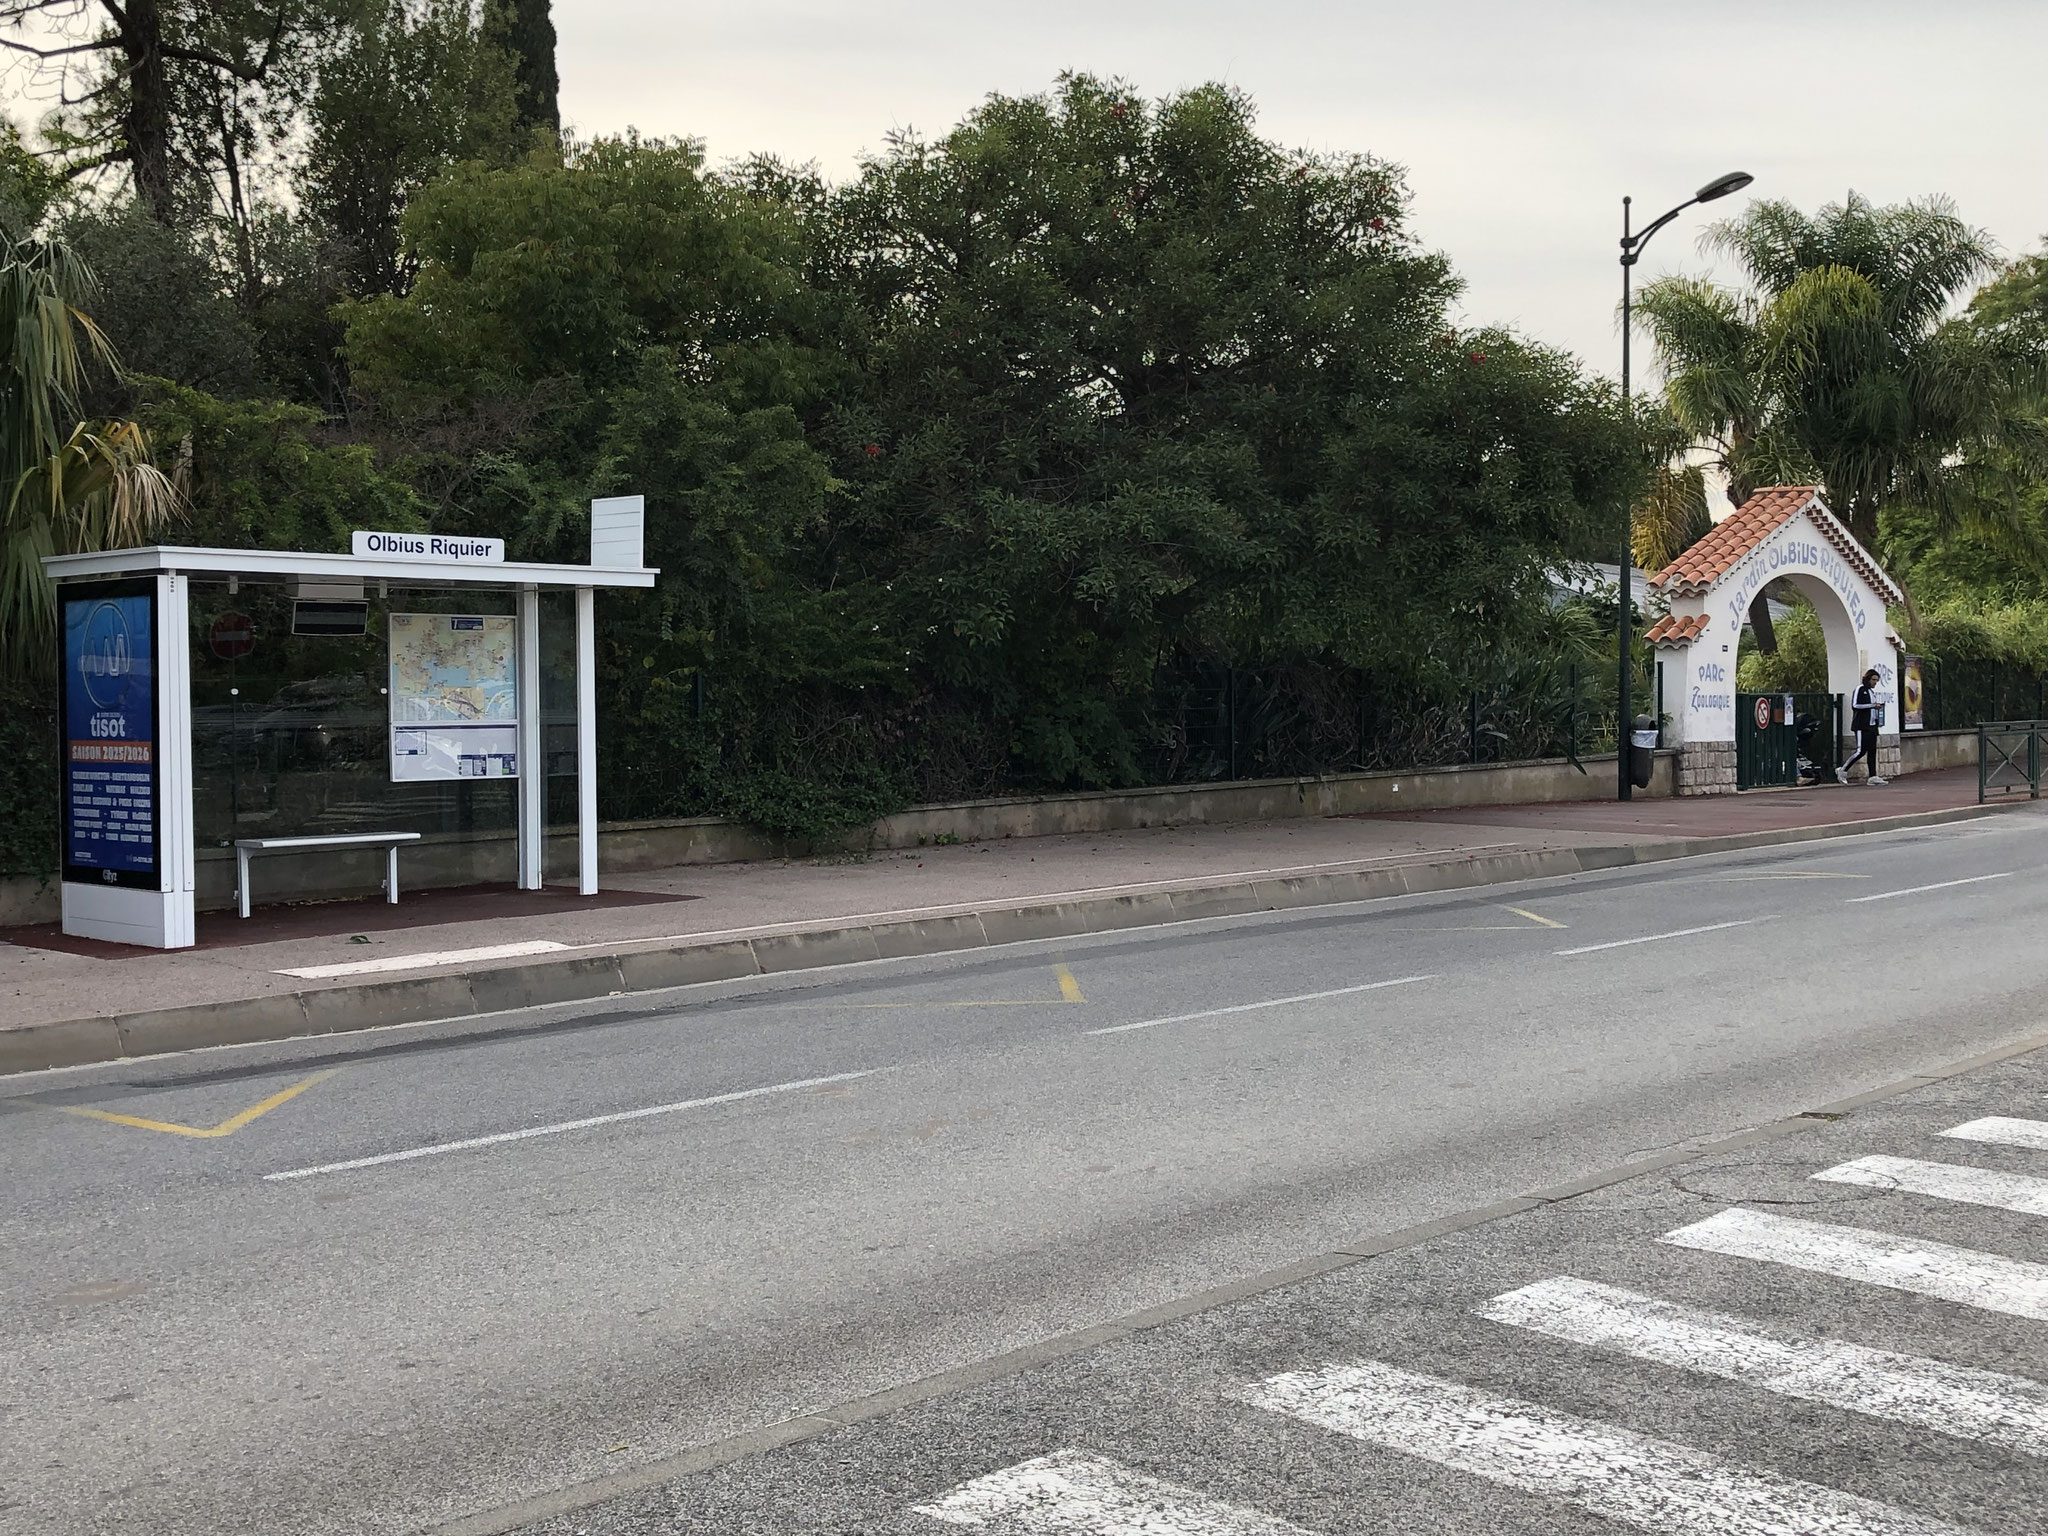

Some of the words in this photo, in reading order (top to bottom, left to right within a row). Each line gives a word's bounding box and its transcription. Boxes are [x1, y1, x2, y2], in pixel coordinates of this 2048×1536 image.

[367, 534, 424, 554] Olbius
[430, 538, 492, 559] Riquier
[1729, 559, 1769, 631] Jardin
[1698, 662, 1725, 682] PARC
[90, 712, 126, 738] tisot
[72, 745, 101, 760] SAISON
[102, 745, 150, 762] 2025/2026
